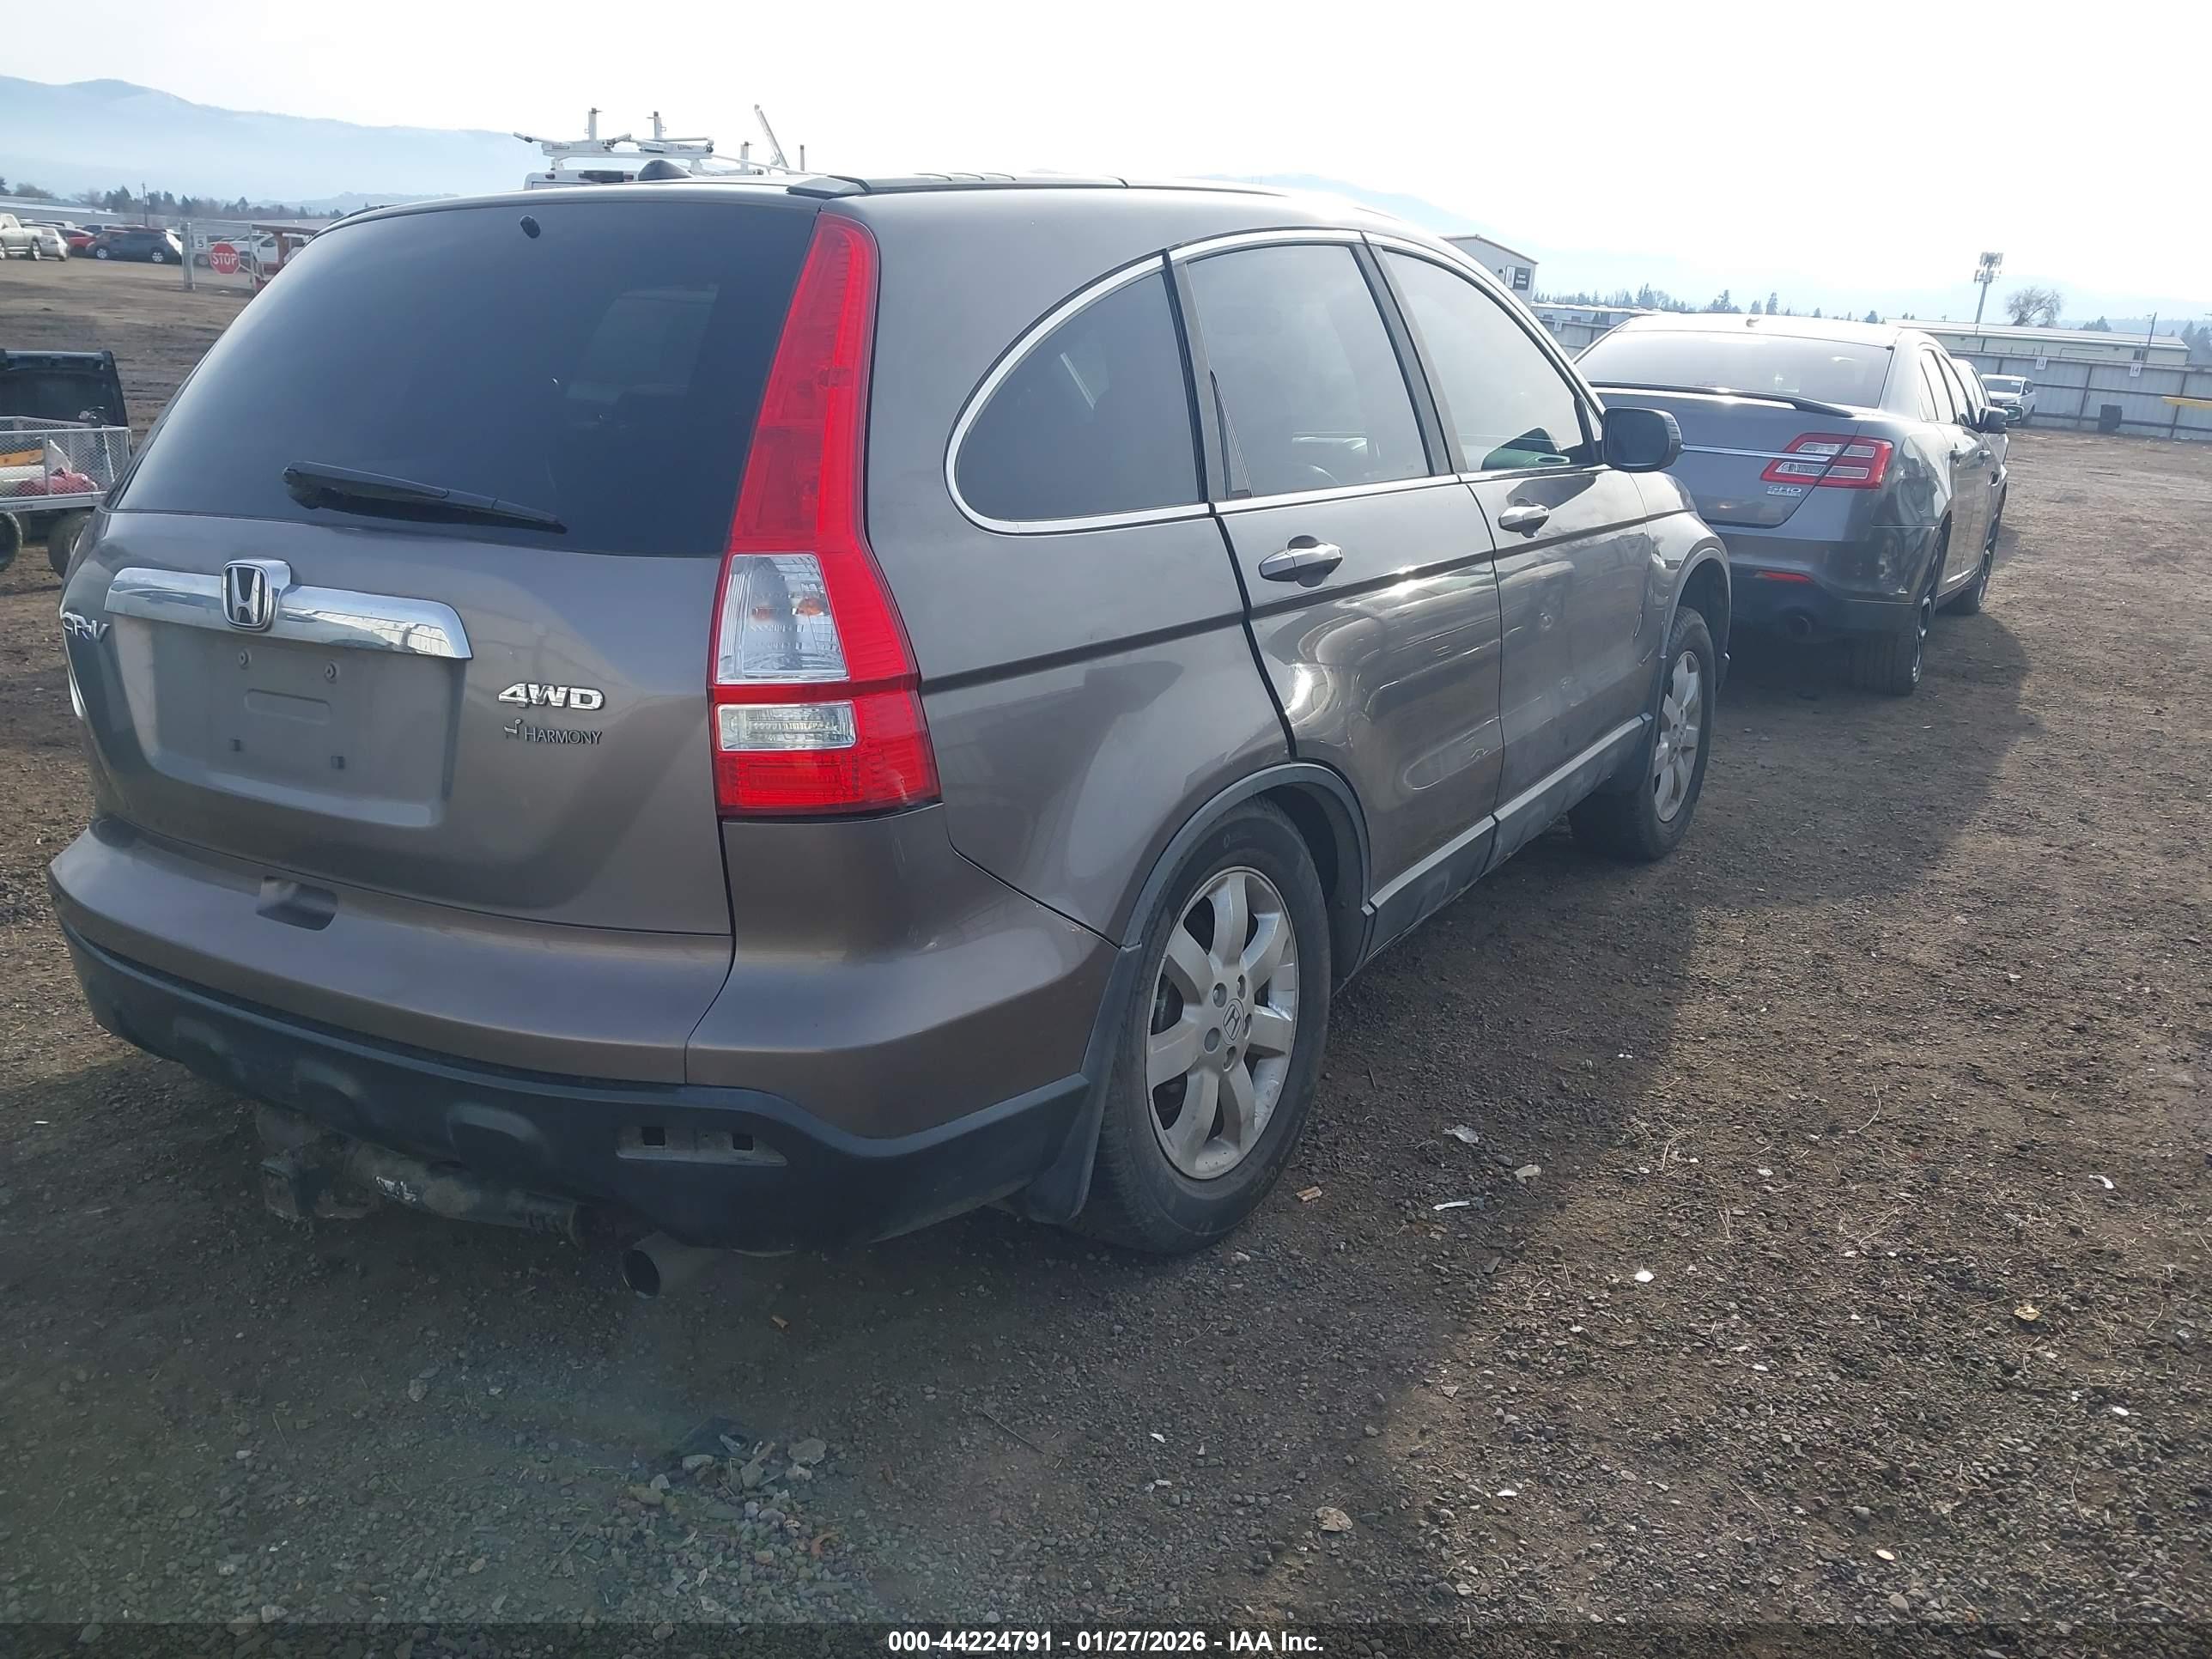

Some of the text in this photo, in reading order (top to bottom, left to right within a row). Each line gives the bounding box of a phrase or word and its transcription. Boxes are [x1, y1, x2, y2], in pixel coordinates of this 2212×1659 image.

[212, 252, 237, 265] STOP
[61, 611, 111, 644] CR-V
[498, 683, 605, 709] 4WD
[524, 726, 603, 744] HARMONY
